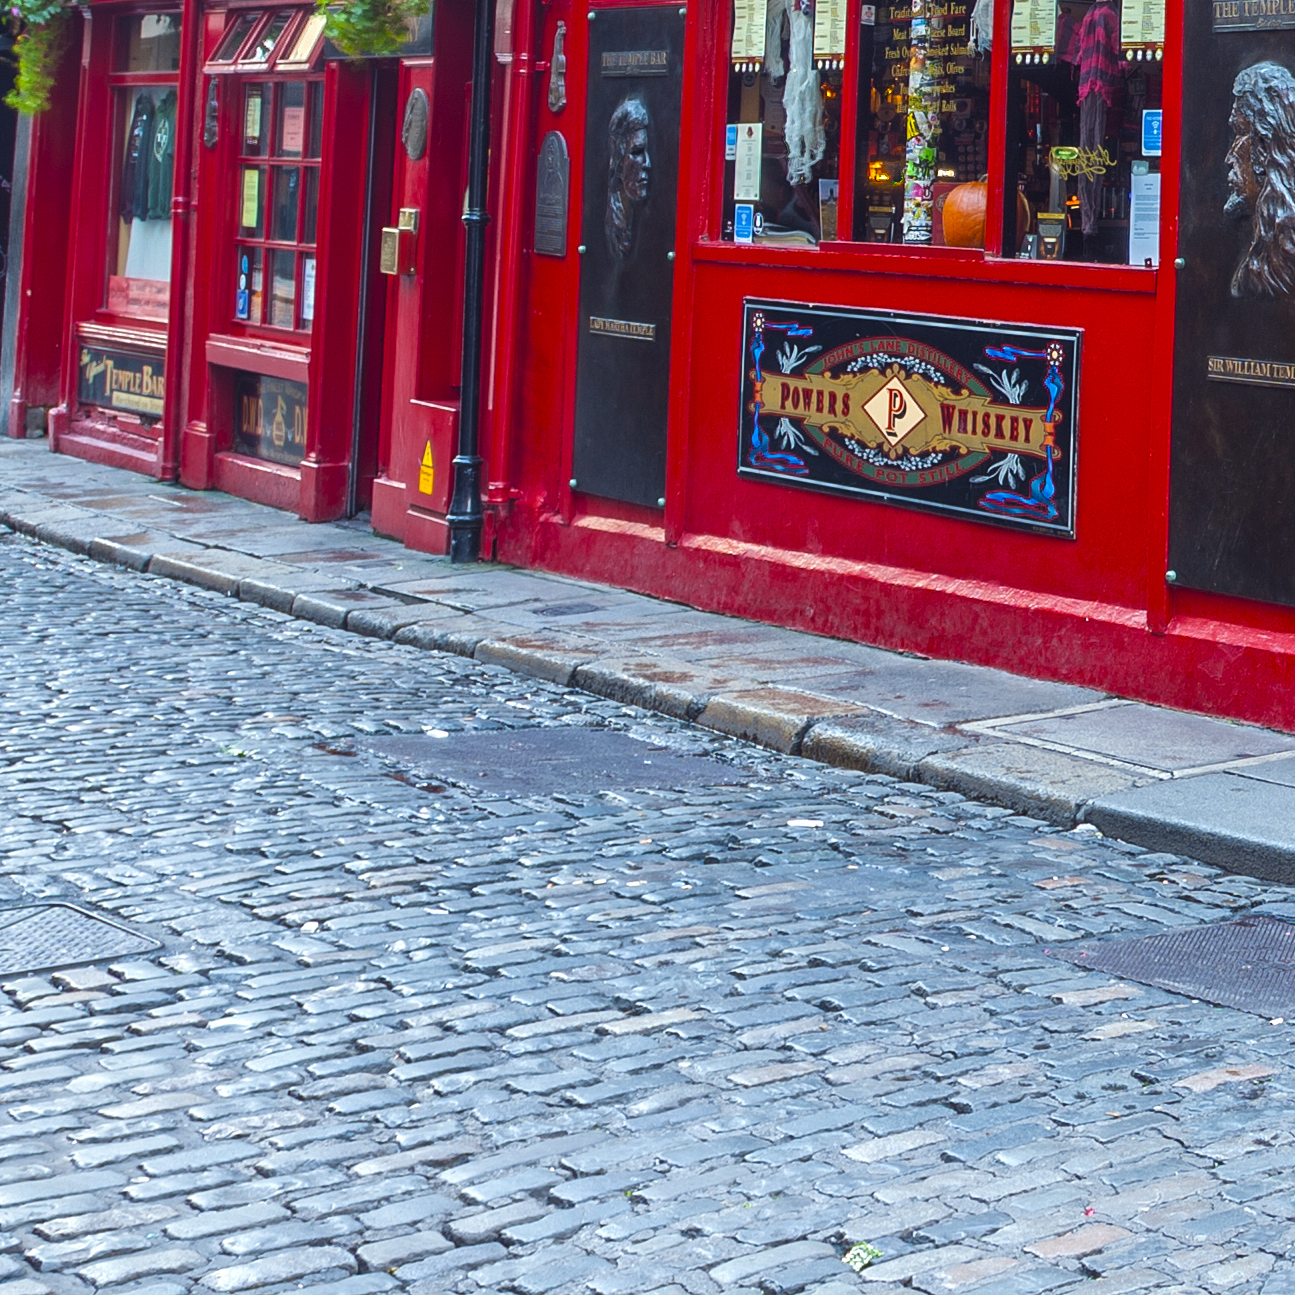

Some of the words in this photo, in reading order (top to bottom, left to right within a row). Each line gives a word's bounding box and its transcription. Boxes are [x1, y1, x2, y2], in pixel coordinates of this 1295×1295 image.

[950, 1, 967, 15] Fare
[1213, 0, 1240, 20] THE
[947, 23, 966, 37] Board
[650, 50, 667, 65] BAR
[822, 341, 865, 370] JOHN'S
[869, 339, 902, 352] LANE
[906, 343, 971, 385] DISTILLERY
[1208, 358, 1223, 373] SIR
[1224, 359, 1271, 379] WILLIAM
[105, 359, 142, 397] TEMPLE
[779, 381, 851, 418] POWERS
[885, 386, 907, 438] P
[939, 401, 1034, 445] WHISKEY
[822, 437, 866, 472] PURE
[875, 469, 908, 484] POT
[917, 461, 966, 483] STILL
